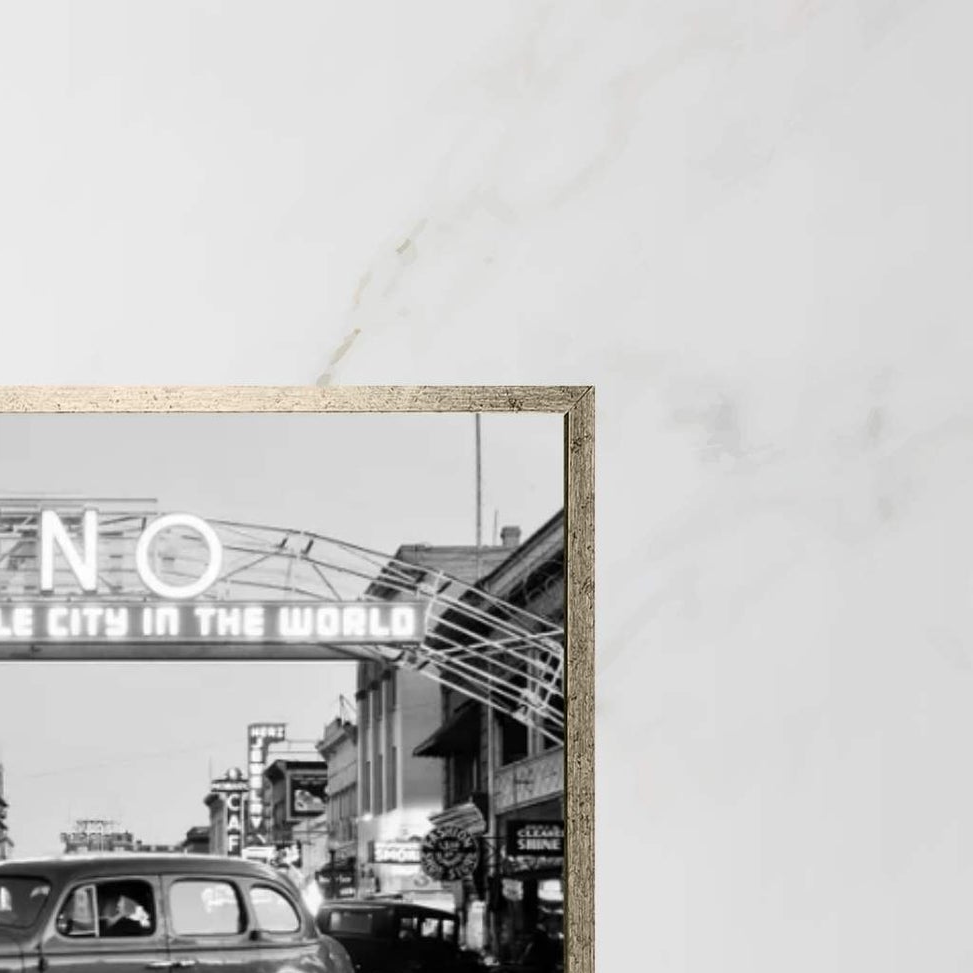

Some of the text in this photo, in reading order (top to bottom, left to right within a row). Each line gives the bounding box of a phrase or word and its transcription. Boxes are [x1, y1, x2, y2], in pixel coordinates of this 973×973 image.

[47, 607, 128, 636] CITY
[142, 607, 180, 636] IN
[194, 607, 265, 636] THE
[279, 607, 414, 636] WORLD
[227, 793, 242, 853] CAF
